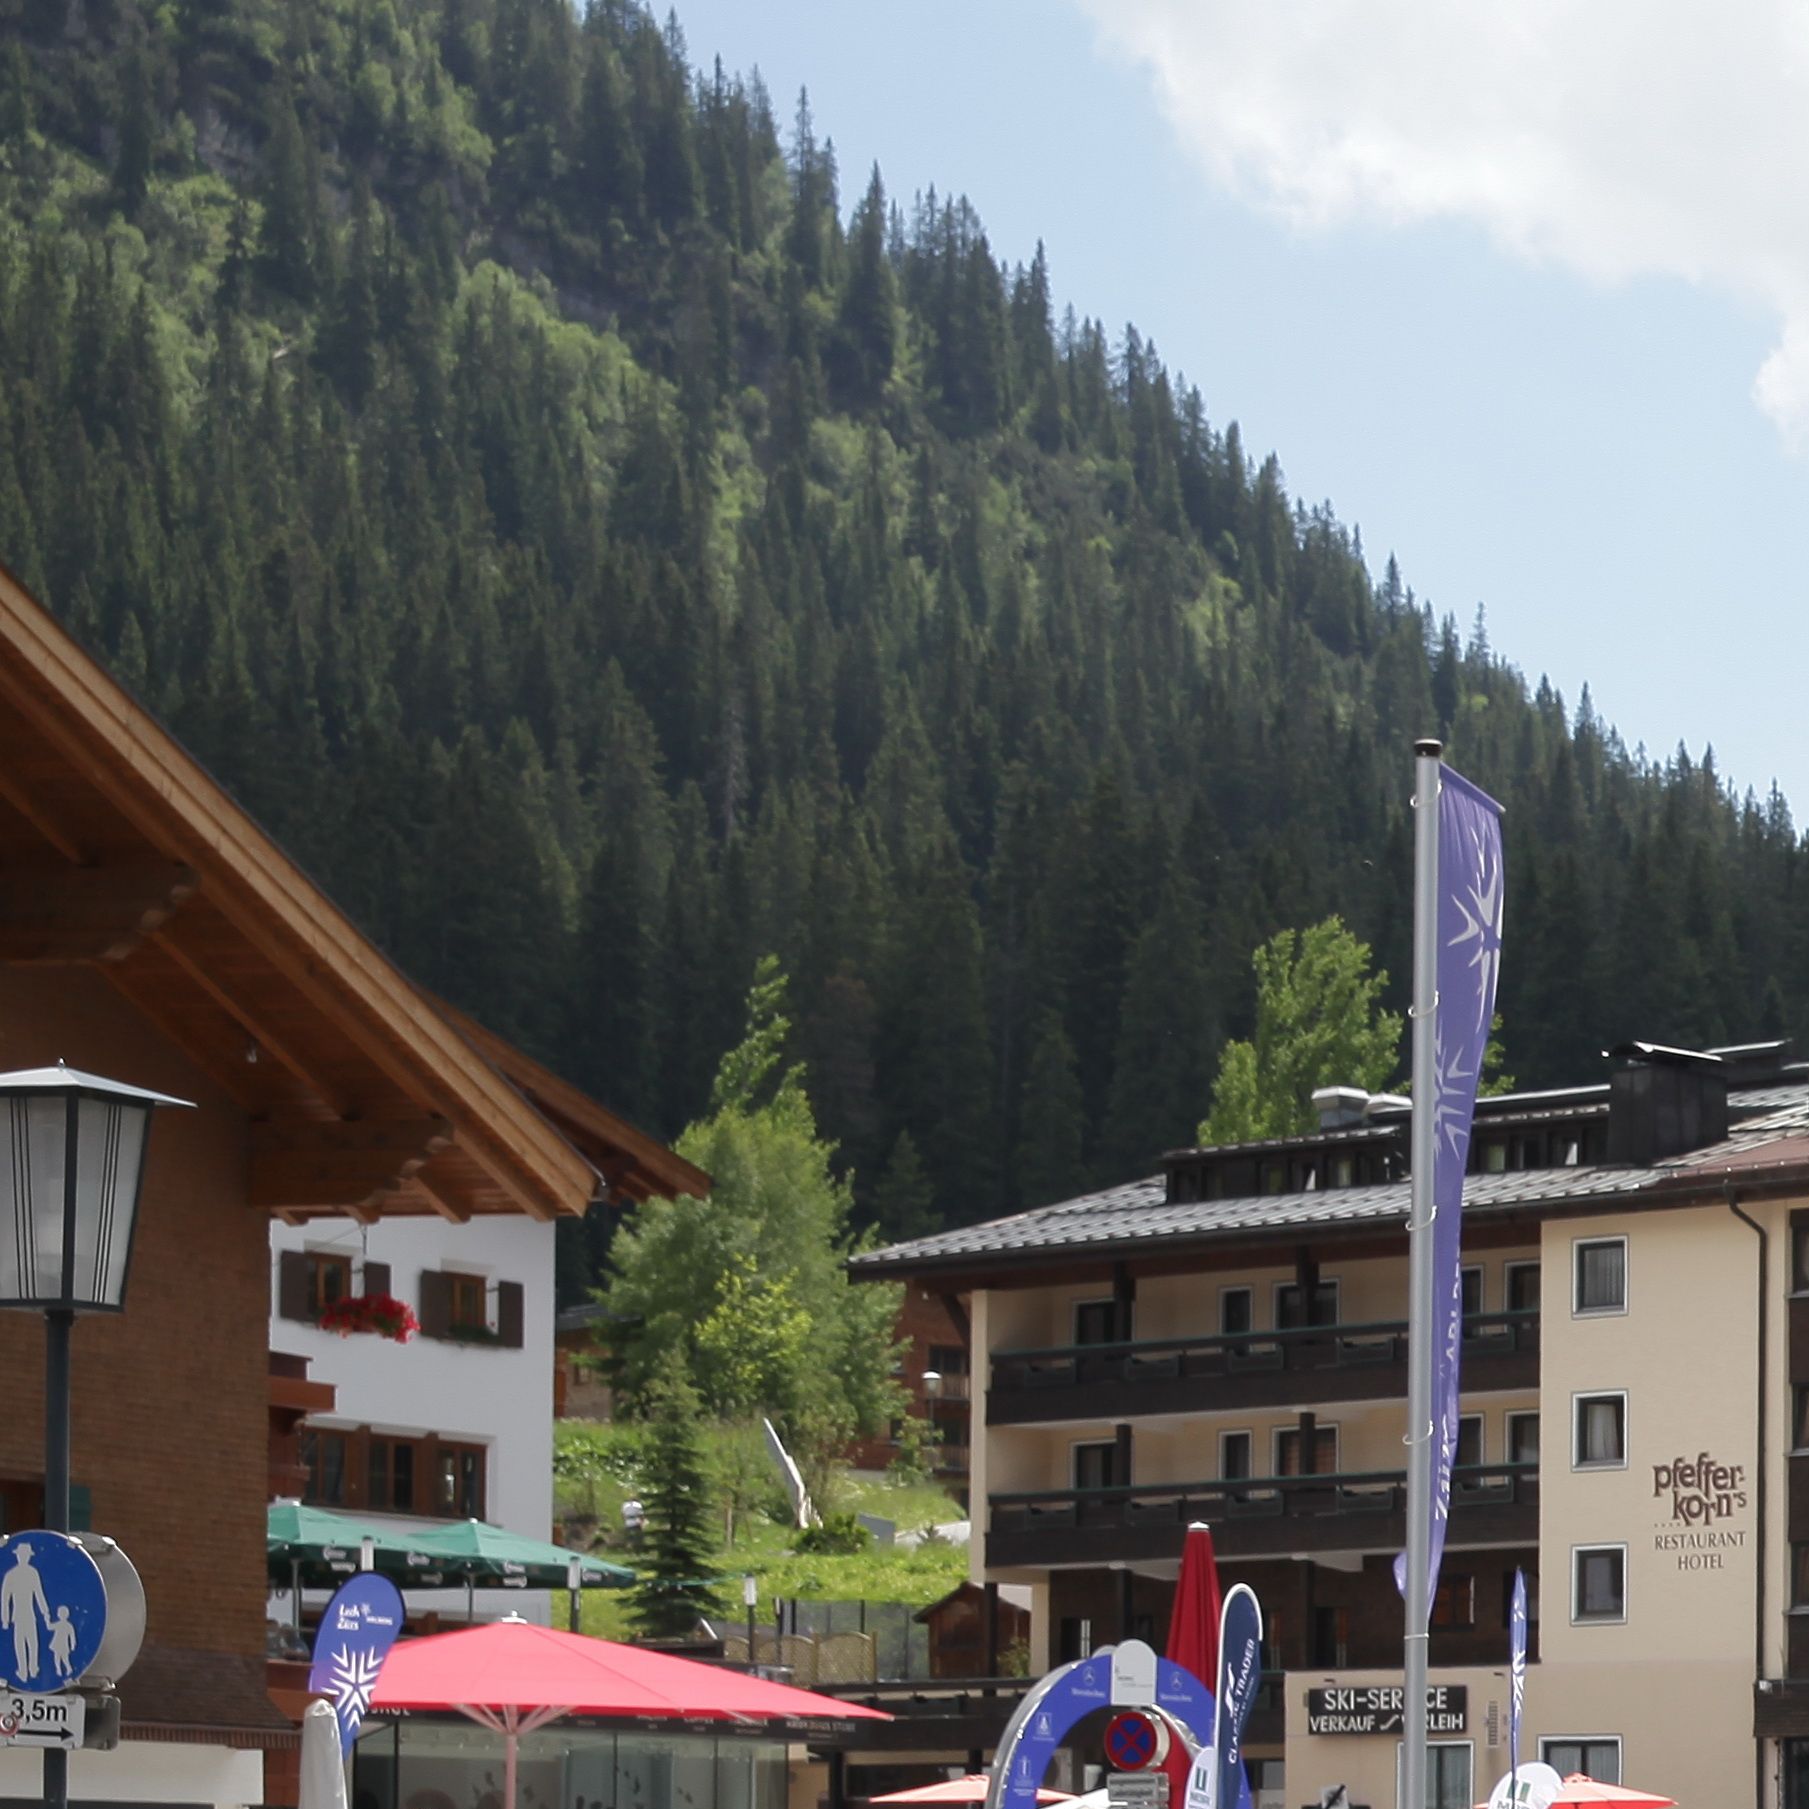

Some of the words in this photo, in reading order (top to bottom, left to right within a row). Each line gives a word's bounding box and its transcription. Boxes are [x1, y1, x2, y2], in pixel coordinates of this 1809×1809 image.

[1655, 1531, 1745, 1550] RESTAURANT
[1678, 1554, 1724, 1571] HOTEL
[1324, 1687, 1447, 1711] SKI-SERCE
[12, 1699, 67, 1724] 3,5m
[1310, 1714, 1376, 1733] VERKAUF
